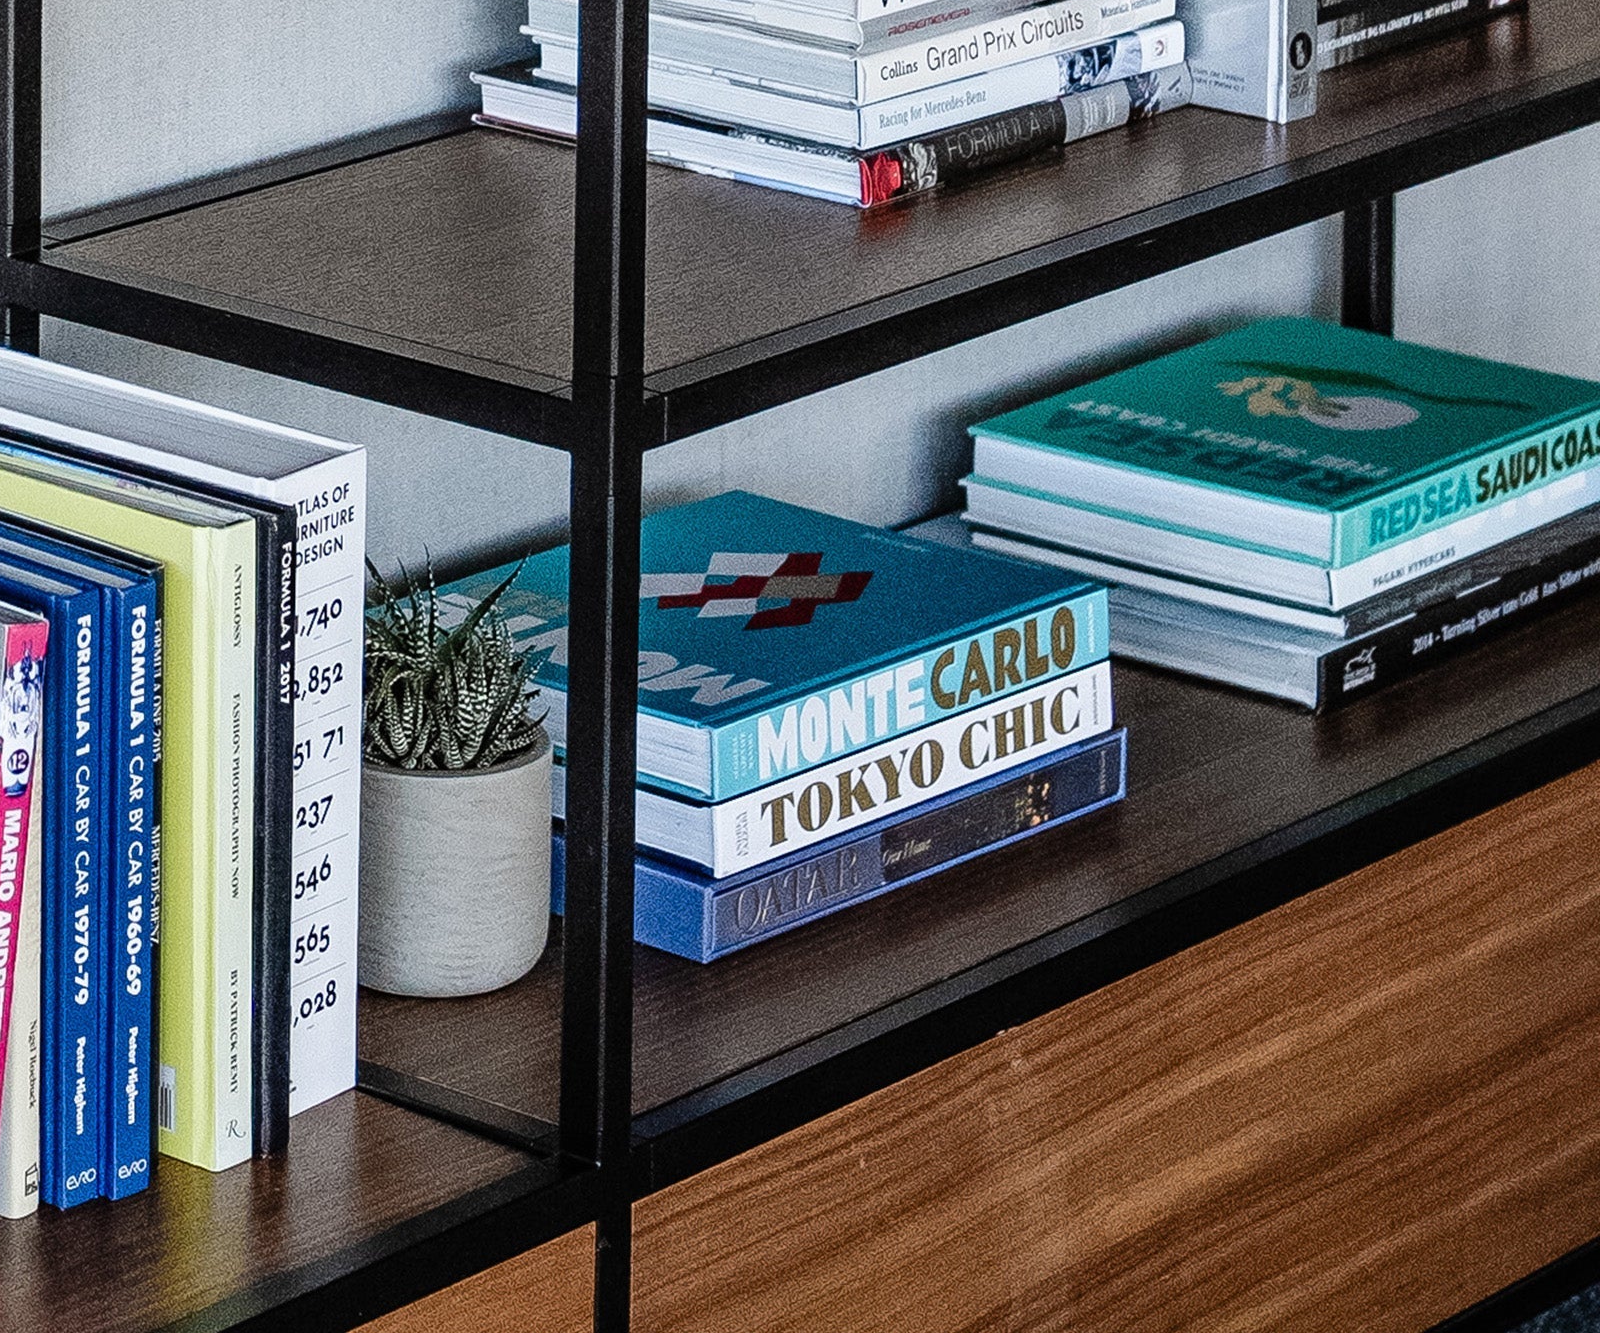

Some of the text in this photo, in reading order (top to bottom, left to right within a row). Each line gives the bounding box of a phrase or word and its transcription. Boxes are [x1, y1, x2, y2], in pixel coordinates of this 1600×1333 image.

[880, 9, 1084, 81] Collins Grand Prix Circuits
[879, 90, 987, 129] Racing for Mercedes-Benz
[947, 112, 1041, 161] FORMULA
[295, 483, 351, 520] TLAS OF
[1369, 492, 1422, 546] RED
[1422, 472, 1472, 524] SEA
[1476, 440, 1547, 503] SAUDI
[296, 505, 355, 543] URNITURE
[296, 537, 344, 568] DESIGN
[232, 563, 243, 649] ANTIGLOSSY
[279, 541, 294, 705] FORMULA 1 2017
[301, 598, 343, 638] ,740
[757, 659, 926, 781] MONTE
[930, 605, 1076, 710] CARLO
[8, 752, 27, 770] 12
[323, 730, 344, 759] 71
[760, 739, 944, 847] TOKYO
[958, 686, 1082, 770] CHIC
[74, 614, 91, 1005] FORMULA 1 CAR BY CAR 1970-79
[127, 605, 147, 995] FORMULA 1 CAR BY CAR 1960-69
[230, 693, 242, 900] FASHION PHOTOGRAPHY NOW
[296, 795, 333, 827] 237
[294, 854, 331, 900] 546
[736, 851, 862, 932] QATAR
[294, 924, 330, 964] 565
[293, 980, 337, 1027] ,028
[229, 969, 238, 1094] BY PATRICK REMY
[75, 1036, 86, 1135] Peter Higham
[127, 1027, 139, 1125] Peter Higham
[66, 1168, 96, 1190] EVRO
[118, 1158, 148, 1179] EVRO
